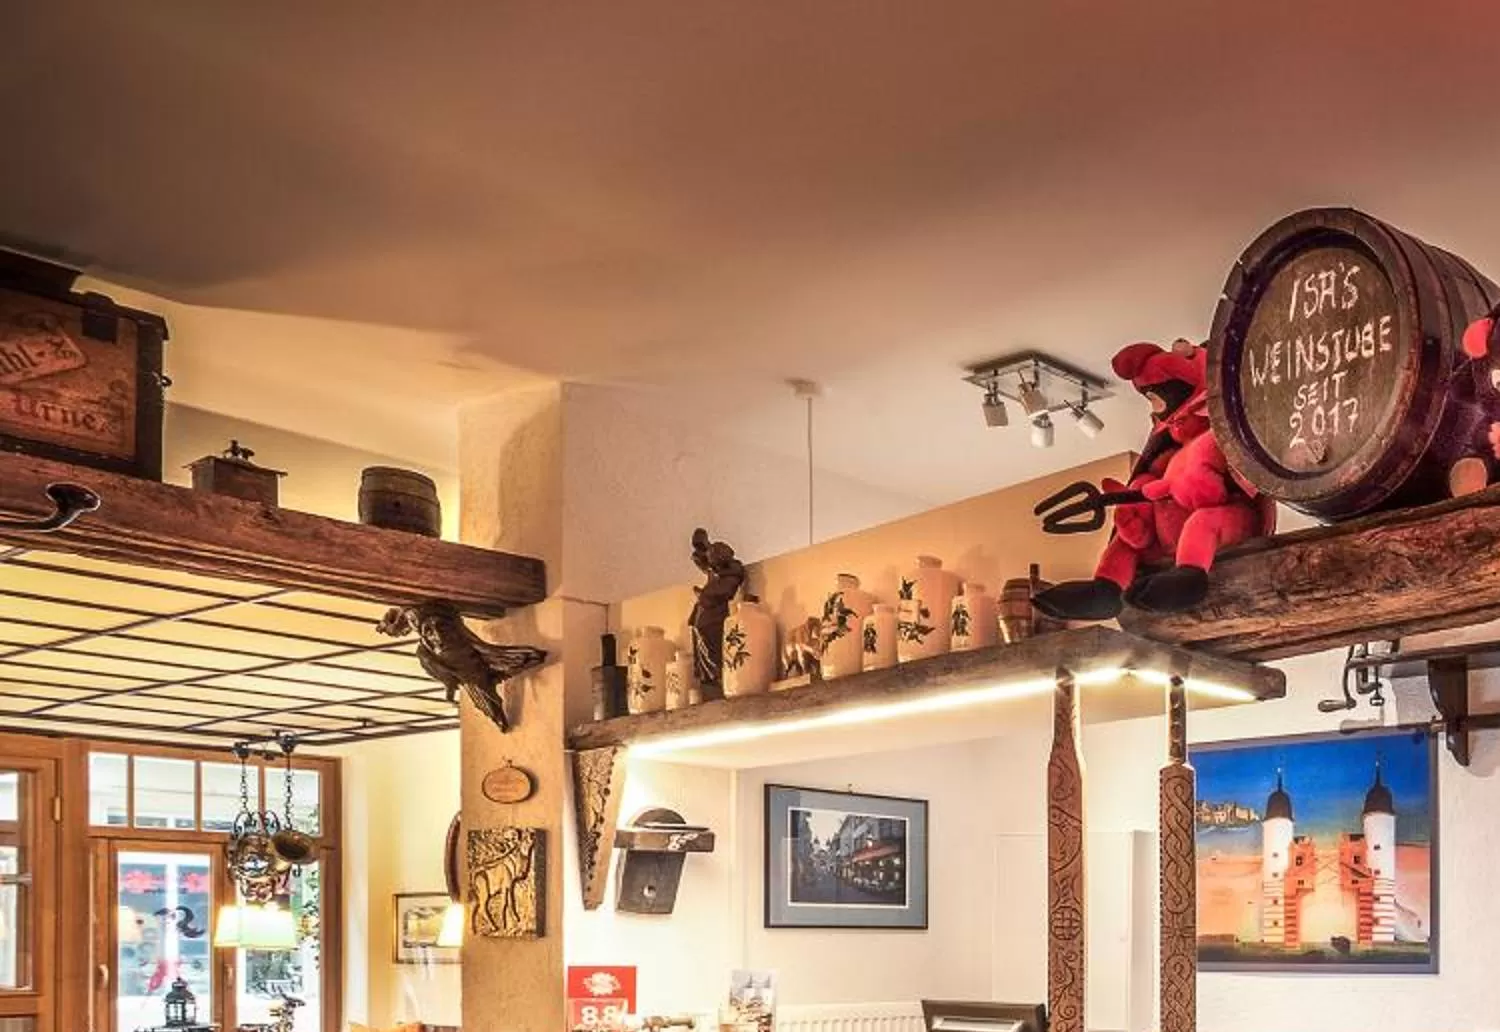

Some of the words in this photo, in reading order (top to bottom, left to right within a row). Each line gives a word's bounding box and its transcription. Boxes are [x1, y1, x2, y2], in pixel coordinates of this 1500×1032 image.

[1288, 261, 1361, 322] ISA'S
[1249, 315, 1393, 387] WEINSTUBE
[1293, 370, 1348, 410] SEIT
[1288, 398, 1360, 449] 2017
